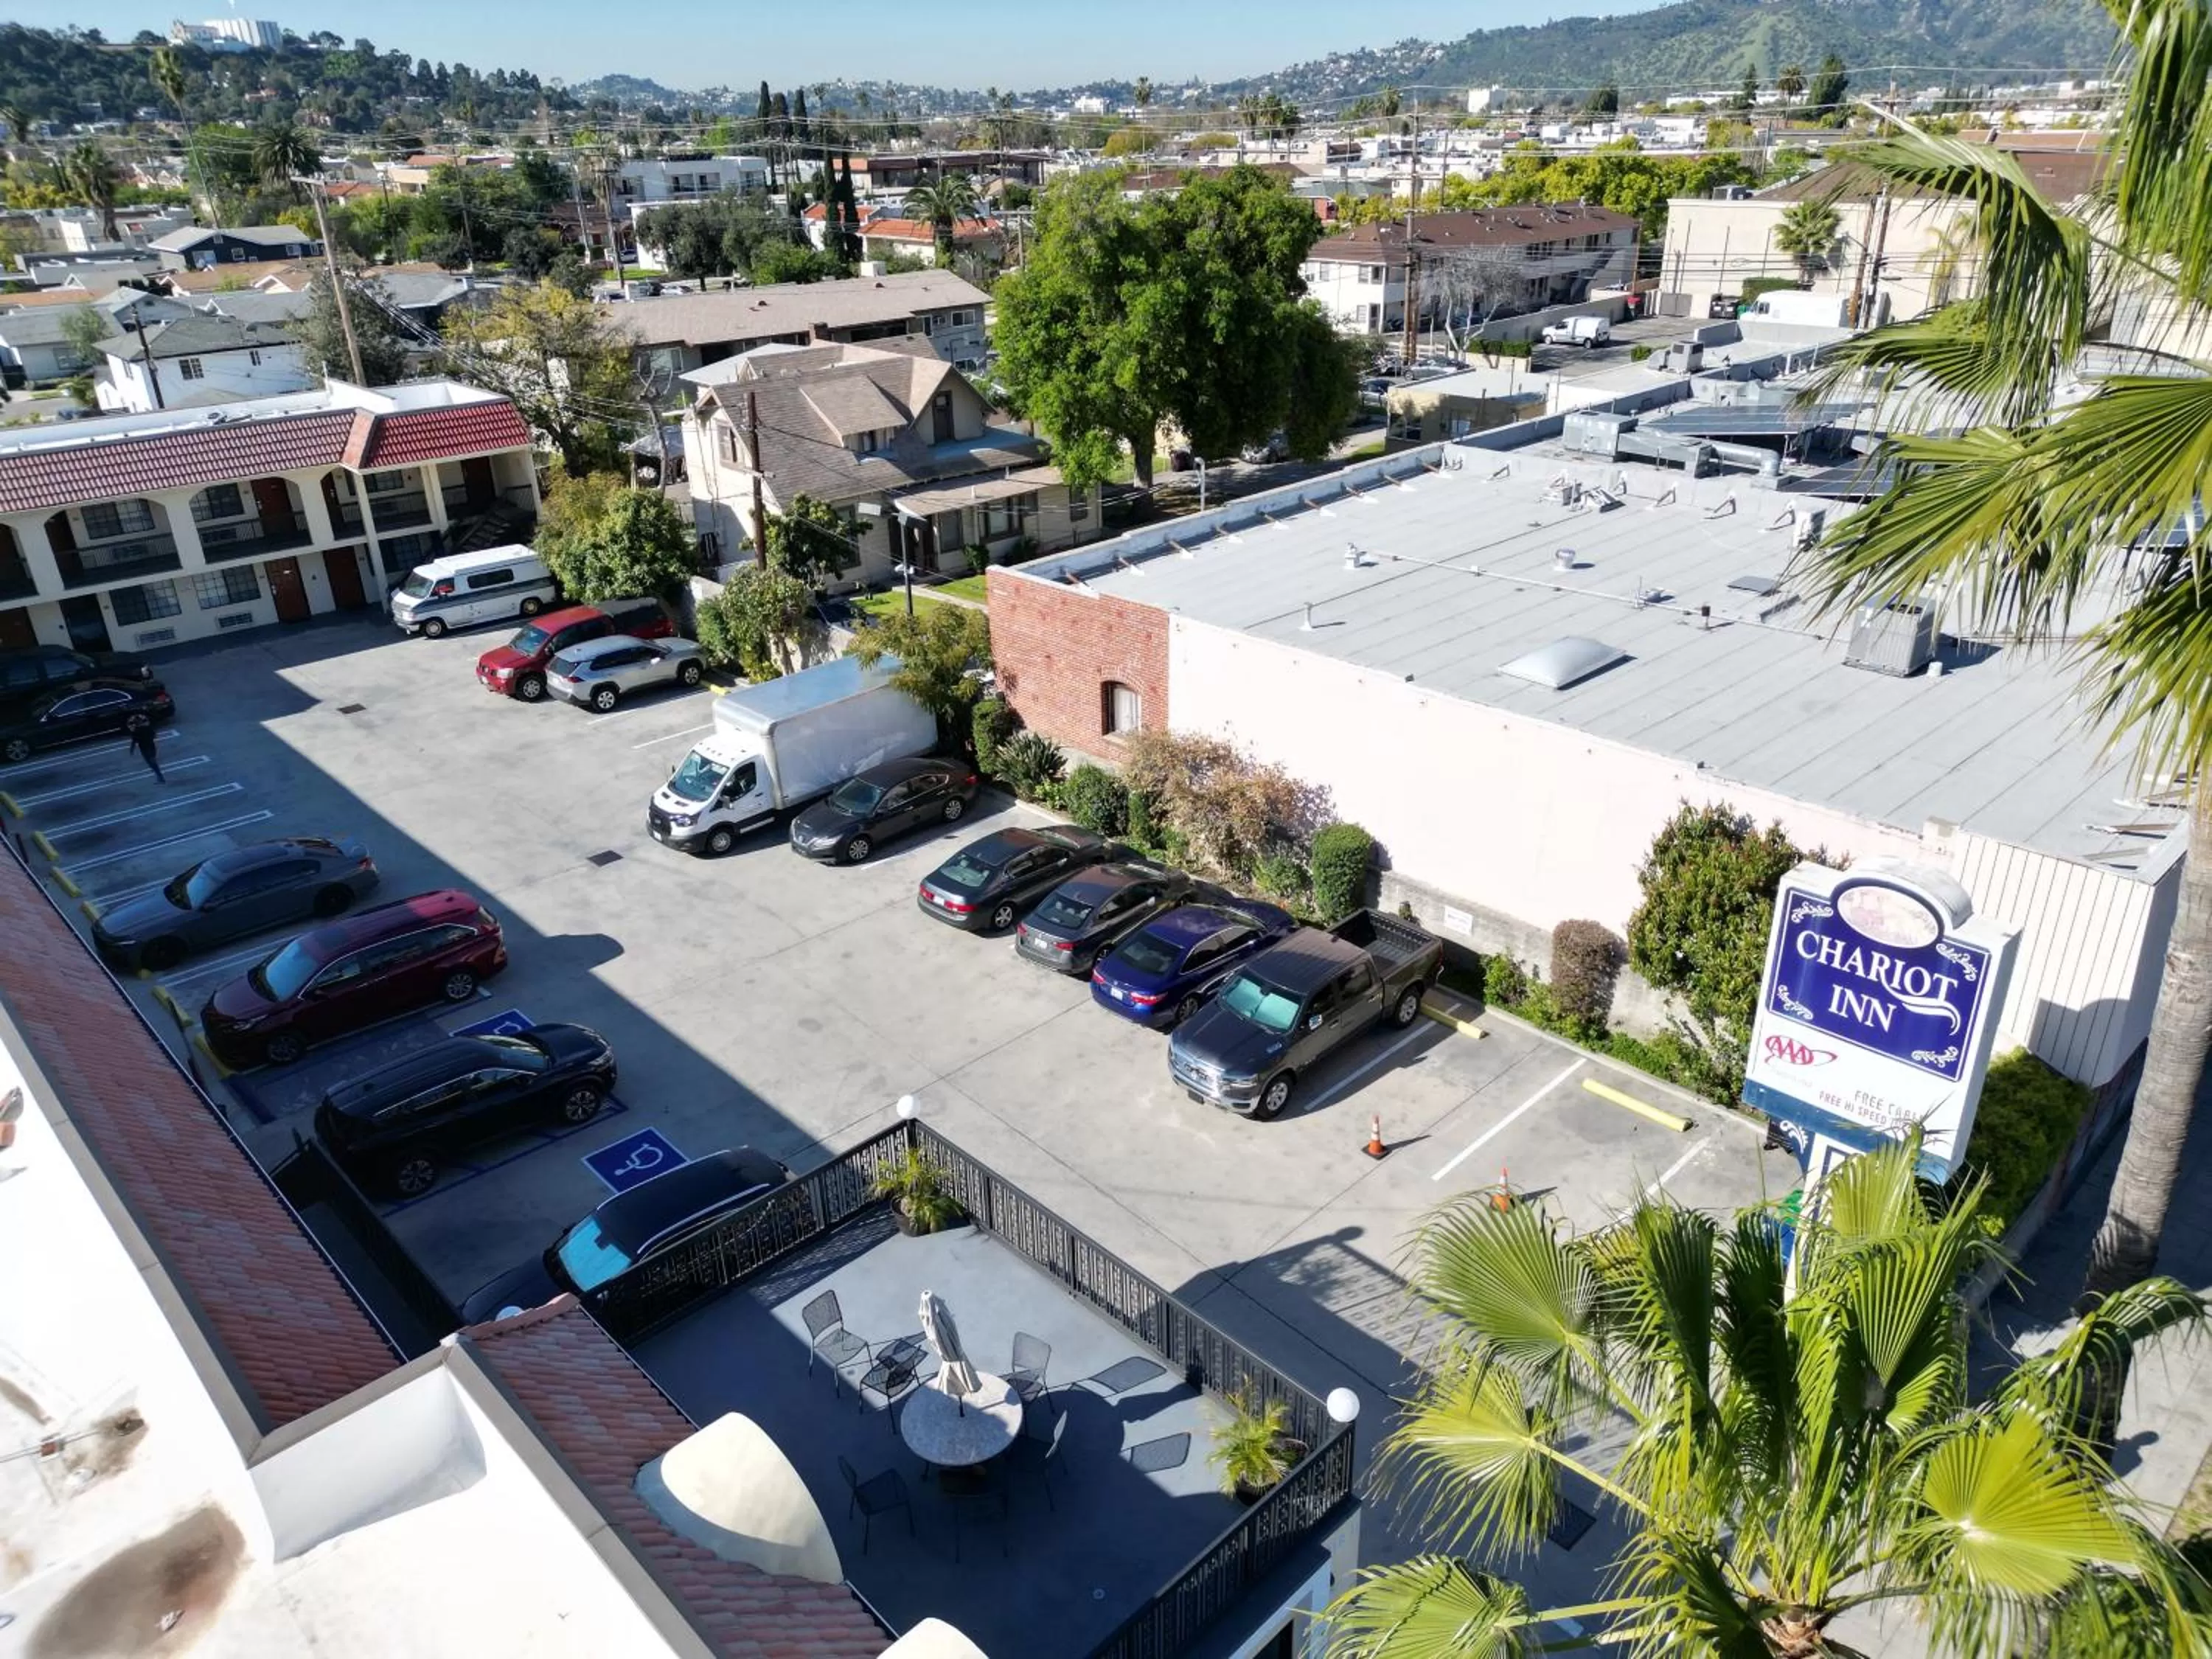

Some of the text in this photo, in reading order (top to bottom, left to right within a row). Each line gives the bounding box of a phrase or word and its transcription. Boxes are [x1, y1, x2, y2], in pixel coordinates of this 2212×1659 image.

[1795, 930, 1961, 1032] CHARIOT
[1828, 984, 1896, 1032] INN
[1765, 1035, 1814, 1065] AAA
[1819, 1091, 1841, 1107] FREE
[1858, 1105, 1887, 1124] SPEED
[1854, 1090, 1884, 1110] FREE
